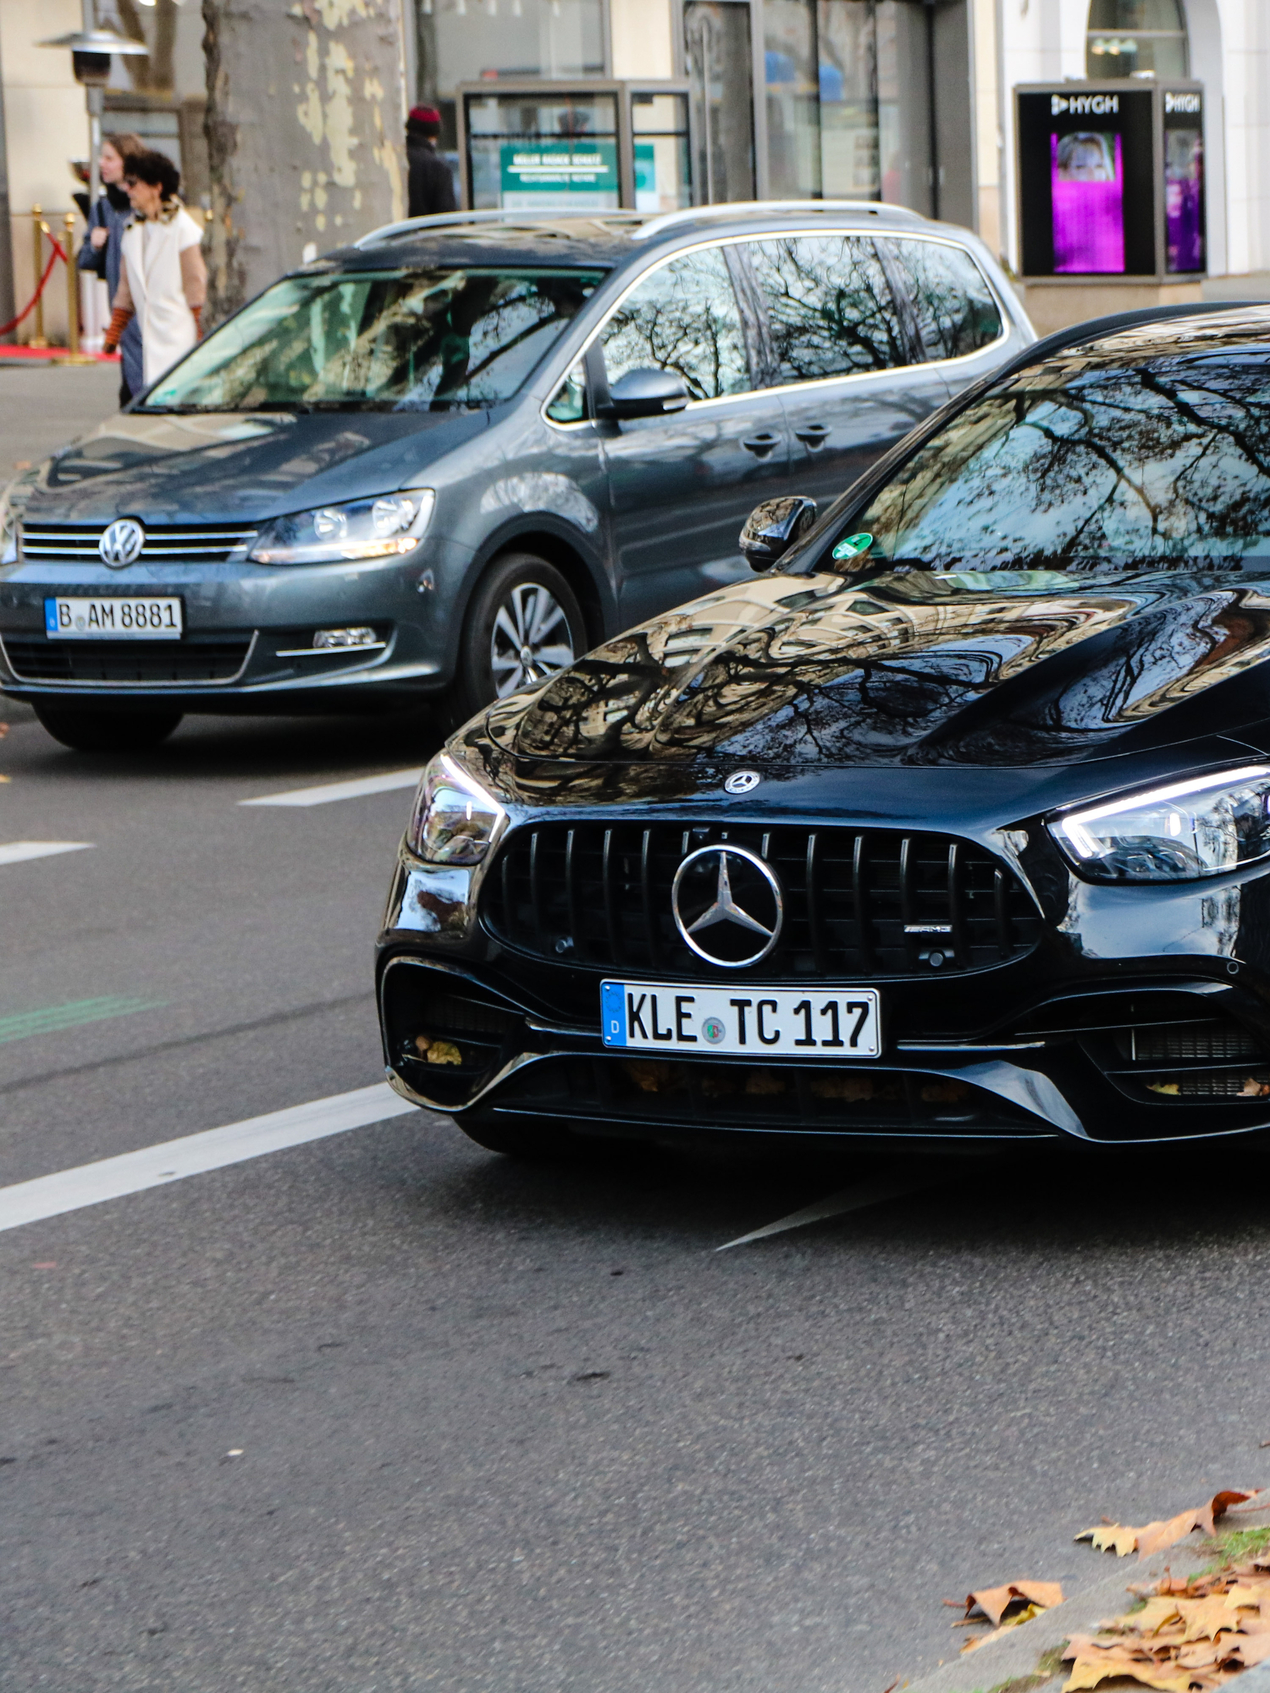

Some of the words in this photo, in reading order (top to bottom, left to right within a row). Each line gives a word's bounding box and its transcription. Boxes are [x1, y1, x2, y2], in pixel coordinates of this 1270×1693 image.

[1069, 95, 1119, 114] HYGH
[1173, 93, 1200, 112] HYGH
[58, 603, 72, 628] B
[88, 603, 115, 628] AM
[121, 603, 178, 628] 8881
[610, 1020, 620, 1034] D
[627, 992, 698, 1043] KLE
[730, 998, 781, 1045] TC
[793, 999, 870, 1047] 117
